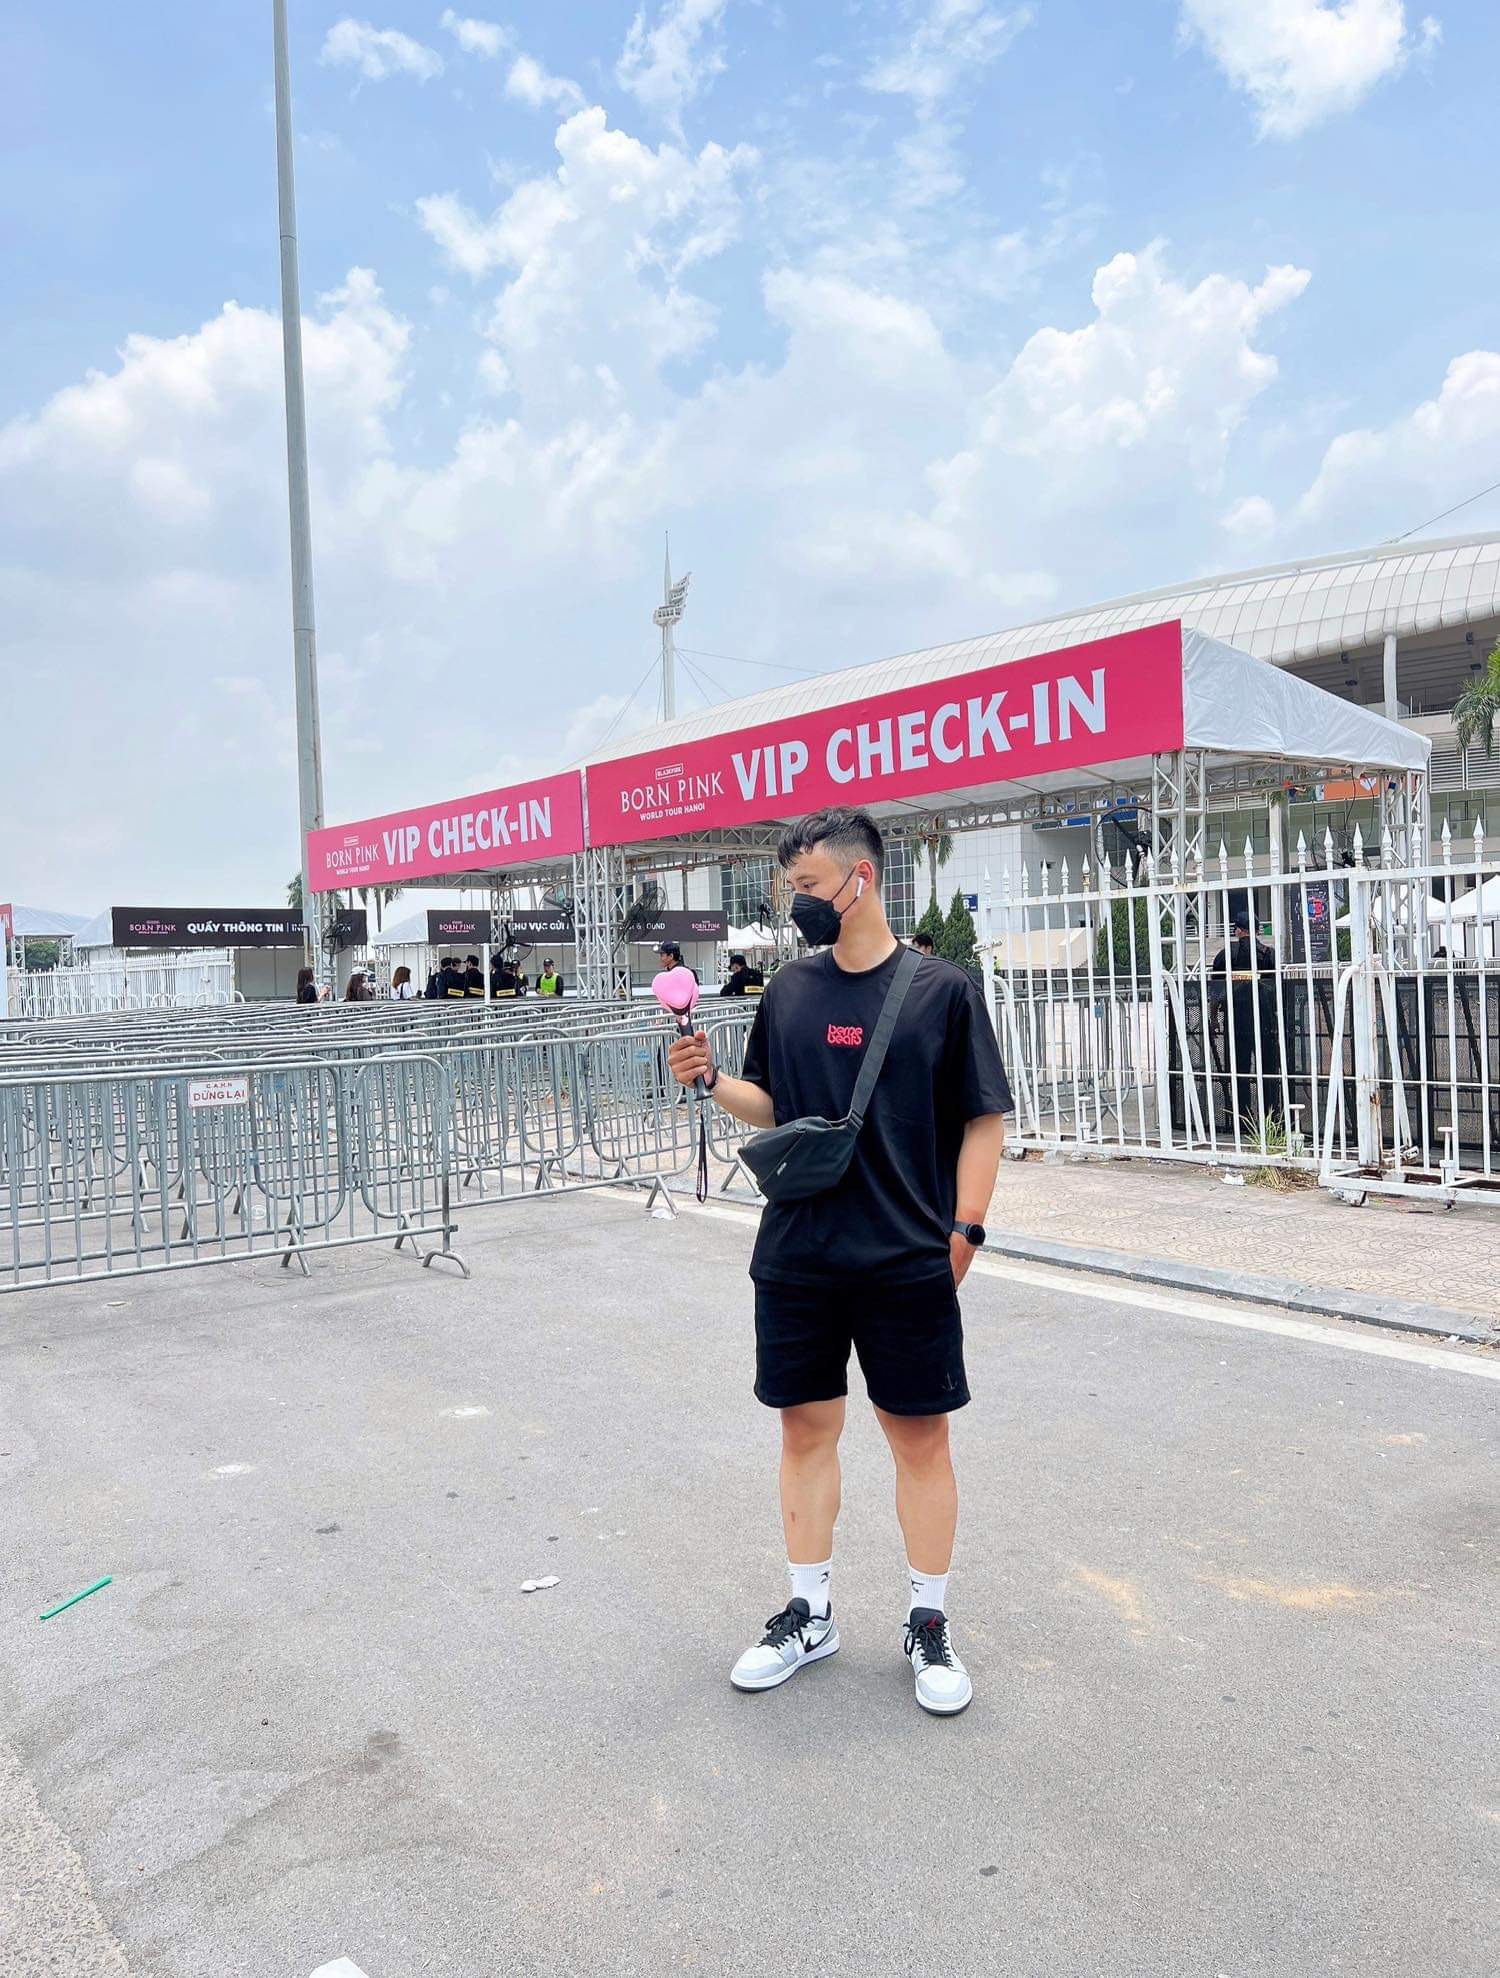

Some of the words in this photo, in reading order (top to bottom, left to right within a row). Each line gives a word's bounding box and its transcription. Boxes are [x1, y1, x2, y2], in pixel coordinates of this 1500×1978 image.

[731, 740, 808, 801] VIP
[825, 667, 1107, 784] CHECK-IN
[620, 782, 671, 813] BORN
[677, 771, 725, 802] PINK
[640, 808, 664, 822] WORLD
[665, 805, 683, 818] TOUR
[684, 802, 705, 815] HANOI
[382, 826, 421, 866] VIP
[428, 797, 552, 858] CHECK-IN
[326, 848, 353, 869] BORN
[355, 843, 379, 864] PINK
[129, 924, 154, 932] BORN
[156, 924, 177, 932] PINK
[265, 923, 284, 933] TIN
[226, 1090, 244, 1100] LẠI
